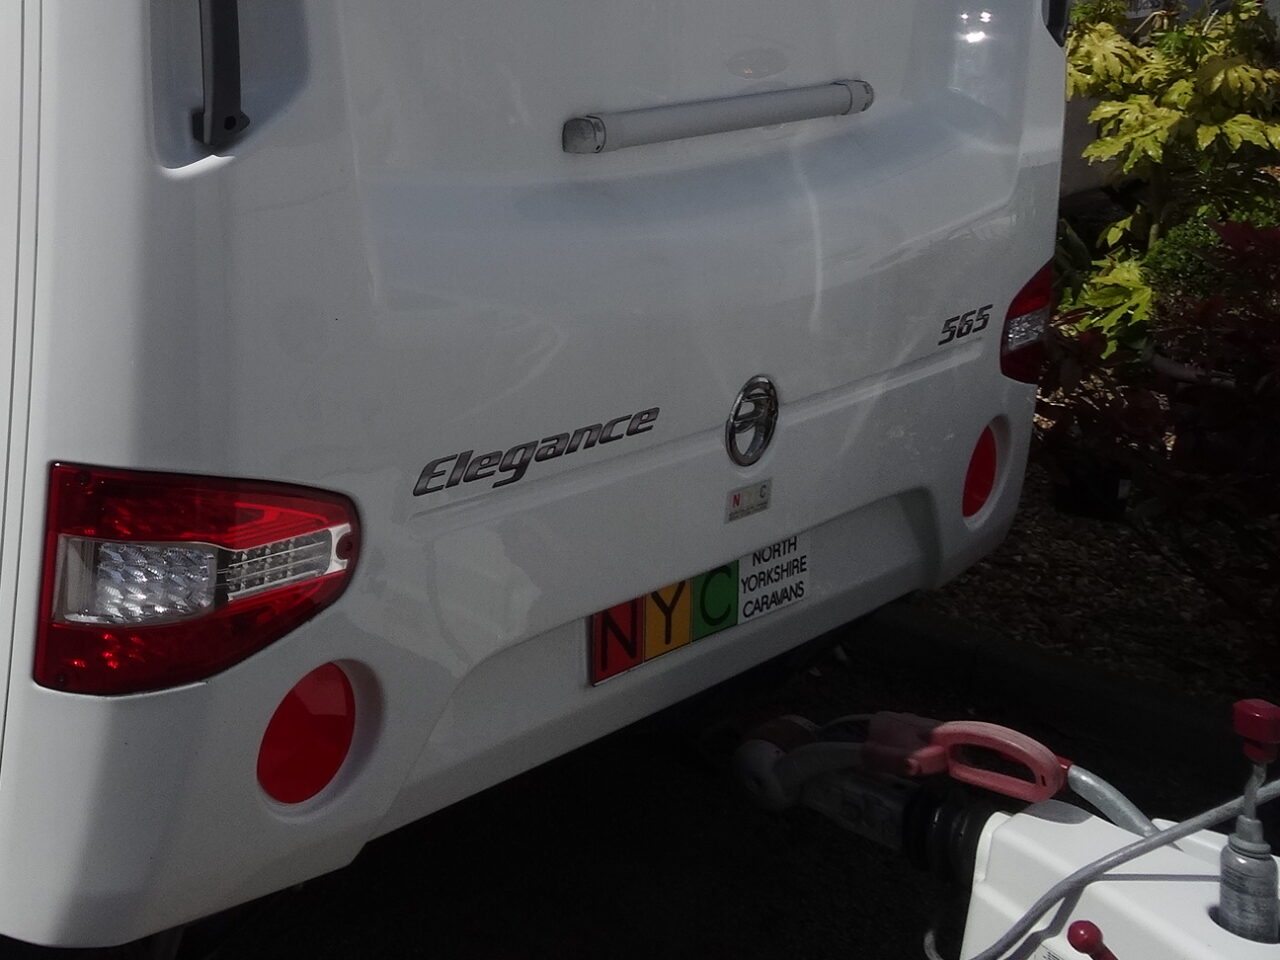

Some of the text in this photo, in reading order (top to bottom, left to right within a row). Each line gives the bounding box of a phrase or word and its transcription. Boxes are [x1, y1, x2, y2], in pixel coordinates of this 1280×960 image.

[937, 304, 994, 346] 565
[412, 407, 661, 497] Elegance
[752, 536, 797, 566] NORTH
[741, 555, 808, 593] YORKSHIRE
[601, 564, 733, 673] NYC
[742, 581, 805, 619] CARAVANS
